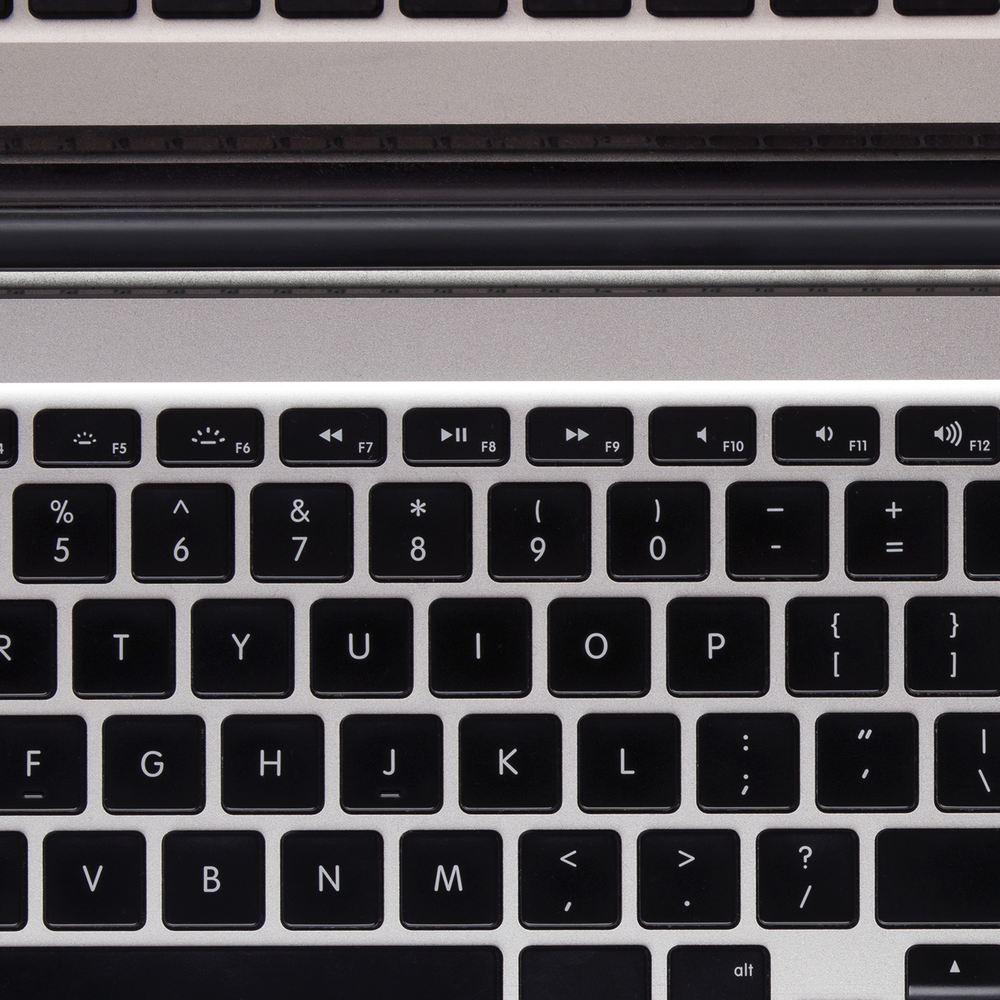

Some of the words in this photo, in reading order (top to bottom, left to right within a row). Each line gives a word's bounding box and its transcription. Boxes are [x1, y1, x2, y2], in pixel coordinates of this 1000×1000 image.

[112, 442, 127, 455] F5
[235, 442, 251, 454] F6
[358, 441, 374, 453] F7
[481, 440, 497, 453] F8
[605, 441, 620, 453] F9
[723, 440, 744, 452] F10
[849, 439, 867, 452] F11
[969, 439, 991, 452] F12
[50, 499, 74, 524] %
[290, 498, 310, 523] &
[535, 499, 541, 523] (
[654, 498, 661, 523] )
[885, 501, 903, 519] +
[53, 537, 70, 563] 5
[173, 536, 189, 562] 6
[291, 536, 308, 562] 7
[410, 536, 427, 562] 8
[530, 536, 546, 562] 9
[885, 541, 904, 553] =
[830, 612, 841, 639] {
[949, 612, 959, 639] }
[112, 633, 130, 661] T
[231, 633, 251, 661] Y
[348, 632, 370, 660] U
[475, 632, 481, 660] I
[584, 632, 608, 660] O
[707, 632, 726, 660] P
[833, 651, 840, 678] [
[950, 651, 957, 678] ]
[26, 750, 42, 777] F
[140, 750, 164, 778] G
[259, 749, 282, 777] H
[382, 748, 396, 776] J
[498, 748, 519, 776] K
[620, 747, 636, 775] L
[978, 769, 991, 793] \
[559, 850, 577, 868] <
[678, 850, 696, 868] >
[798, 845, 813, 870] ?
[82, 865, 104, 892] V
[203, 865, 221, 893] B
[318, 864, 340, 892] N
[434, 864, 463, 892] M
[799, 884, 812, 909] /
[733, 962, 754, 977] alt
